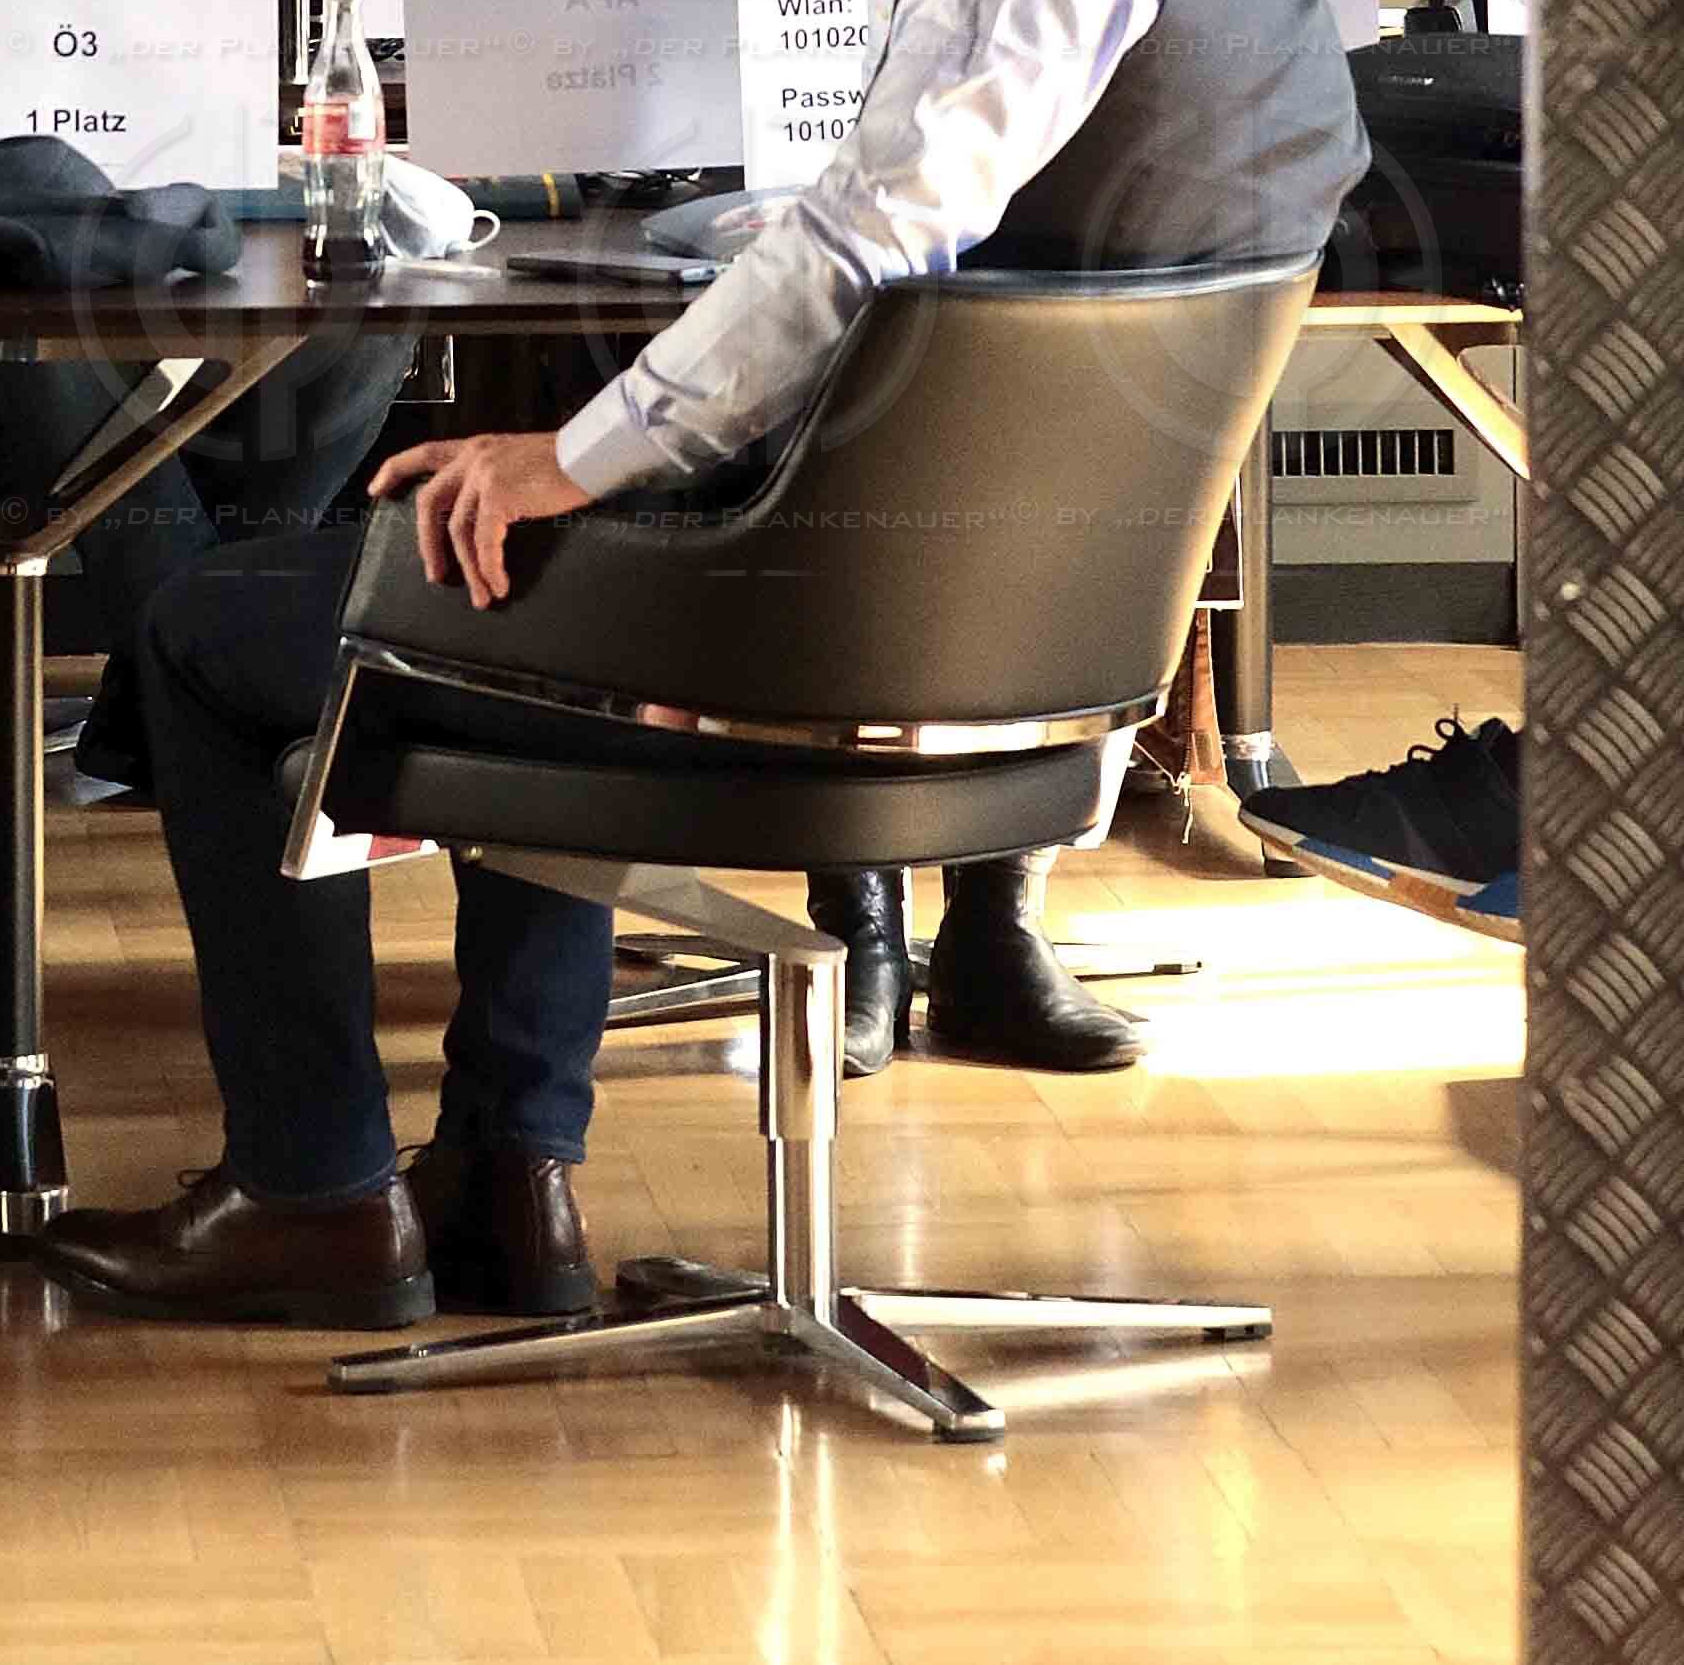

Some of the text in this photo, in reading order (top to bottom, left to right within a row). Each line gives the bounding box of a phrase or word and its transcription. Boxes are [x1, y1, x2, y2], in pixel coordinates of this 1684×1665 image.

[52, 24, 99, 58] Ö3
[26, 109, 127, 133] 1 Platz
